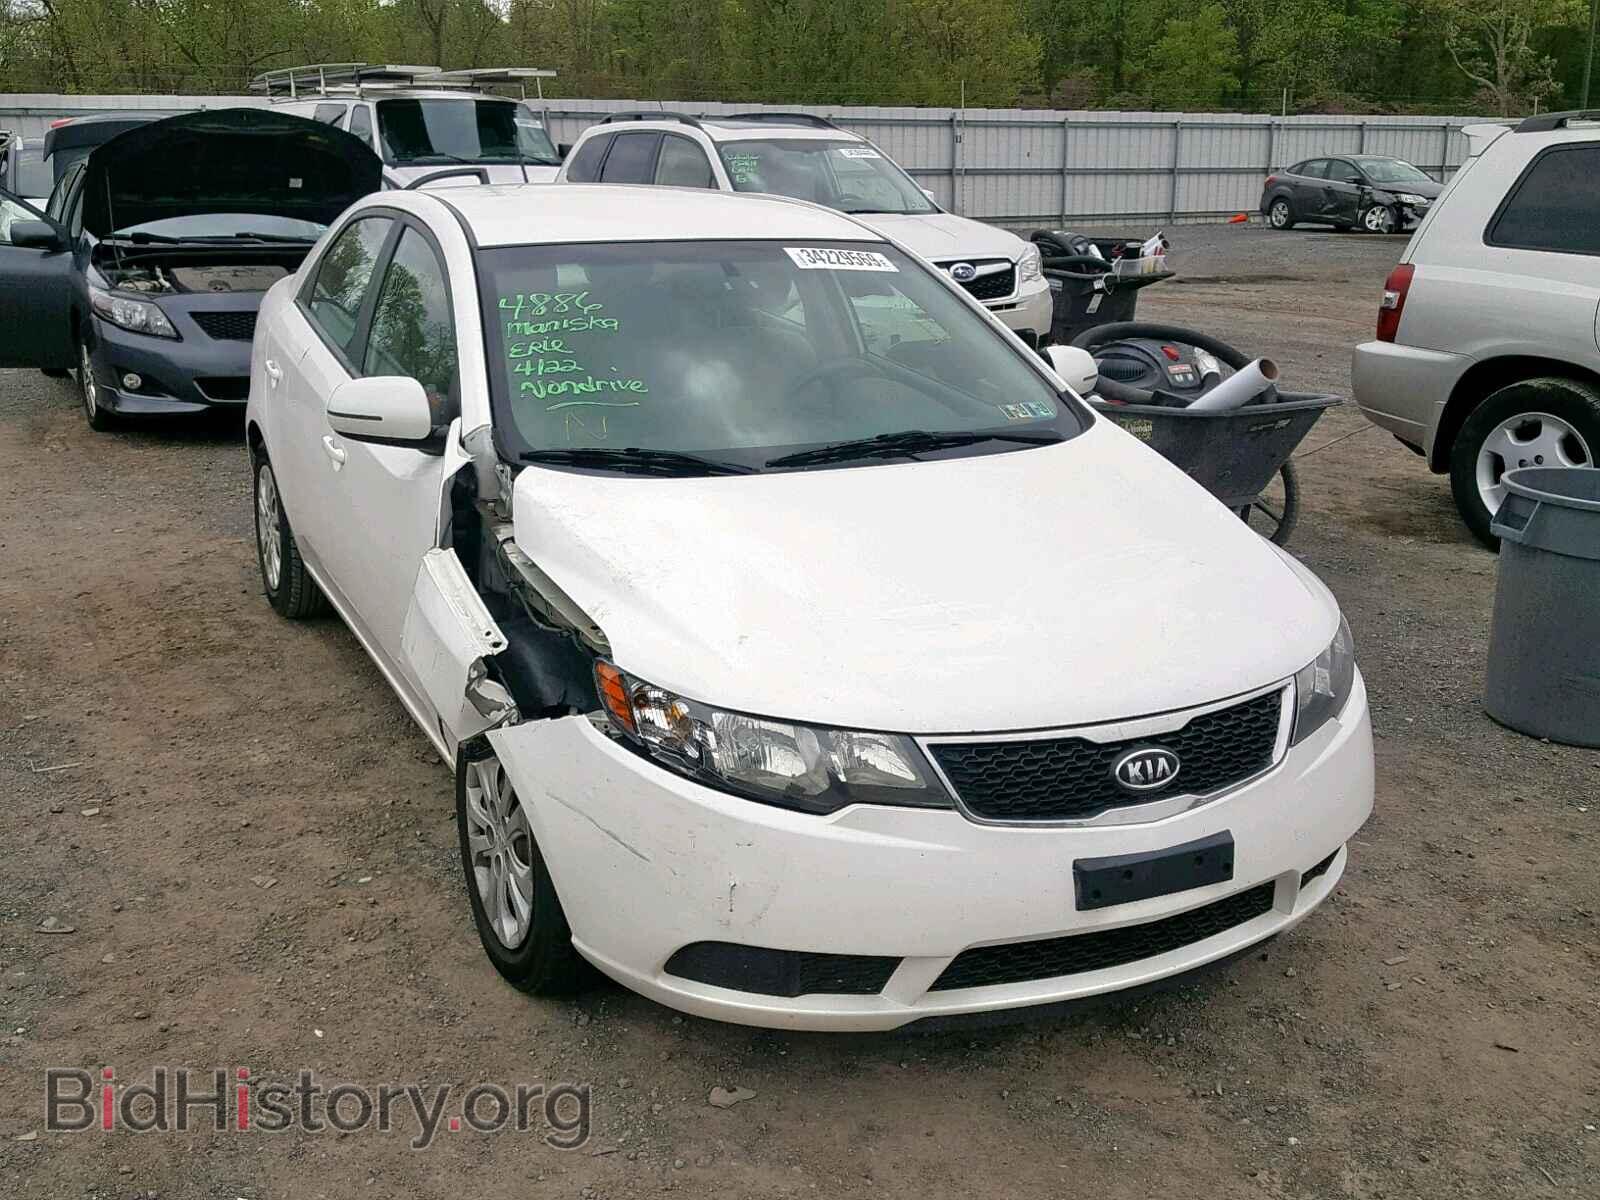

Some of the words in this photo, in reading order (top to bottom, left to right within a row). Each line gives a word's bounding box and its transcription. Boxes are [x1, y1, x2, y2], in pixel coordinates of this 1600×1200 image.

[800, 249, 882, 267] 34229569
[498, 292, 603, 320] 4886
[1128, 757, 1172, 783] KIA
